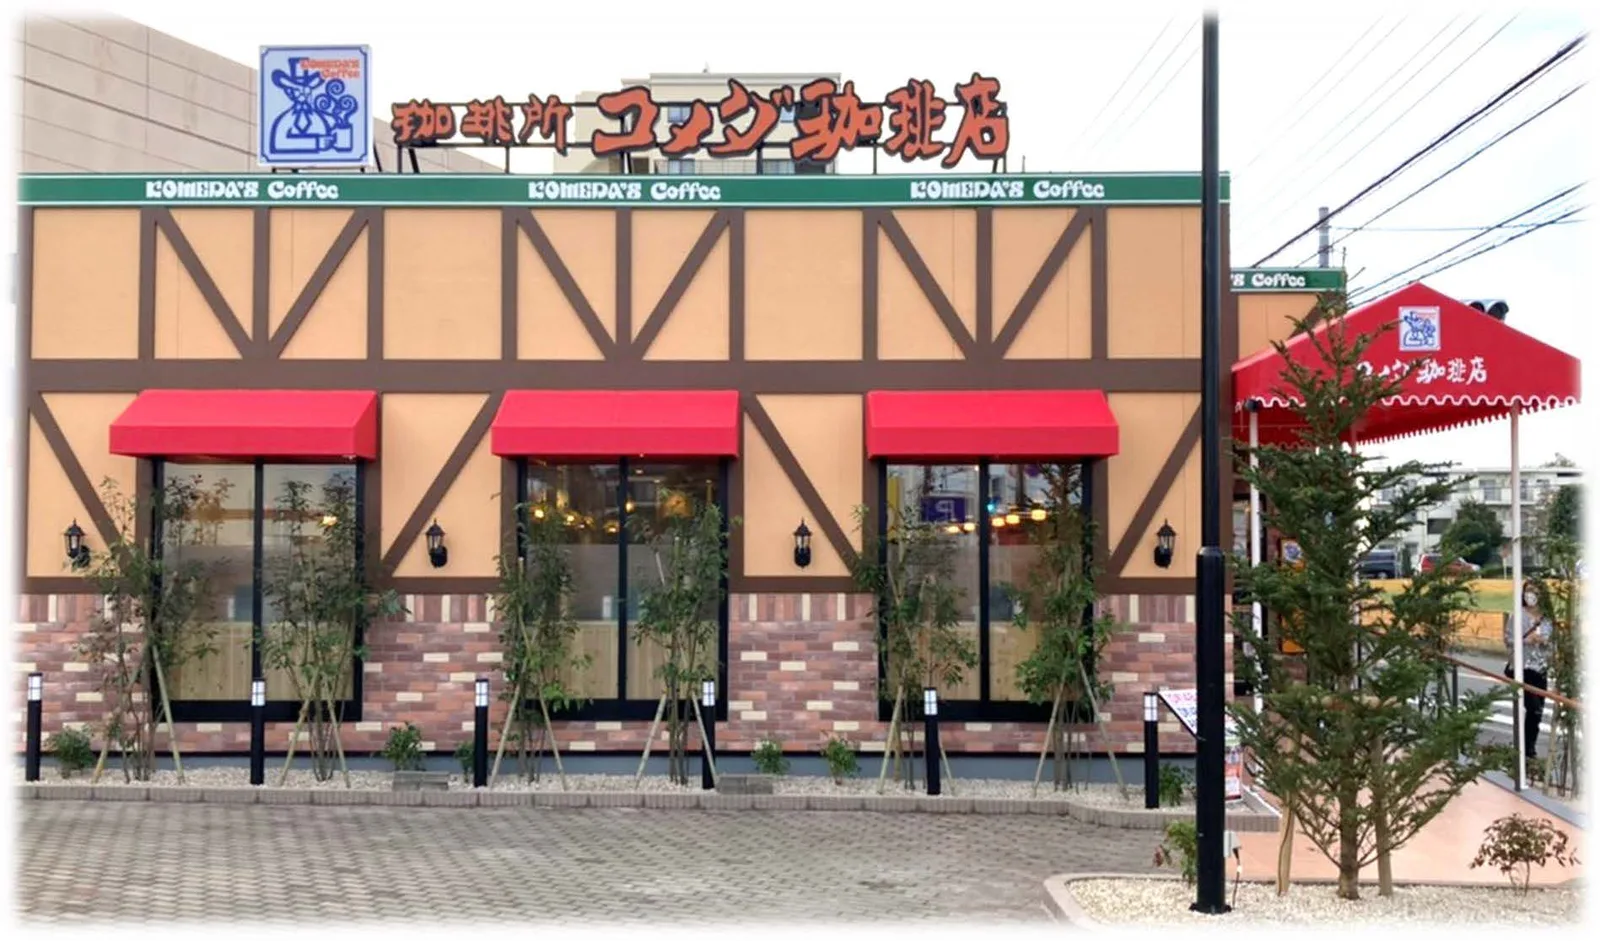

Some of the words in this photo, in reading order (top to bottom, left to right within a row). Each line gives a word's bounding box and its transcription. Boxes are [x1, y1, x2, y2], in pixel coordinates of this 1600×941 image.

[391, 93, 573, 157] 珈琲所
[592, 72, 1010, 168] コメダ珈琲店
[145, 180, 259, 199] KOMEDA'S
[267, 180, 339, 200] Coffee
[528, 181, 642, 200] KOMEDA'S
[650, 181, 721, 201] Coffee
[910, 180, 1024, 199] KOMEDA'S
[1033, 180, 1105, 200] Coffee
[1251, 273, 1306, 288] Coffee
